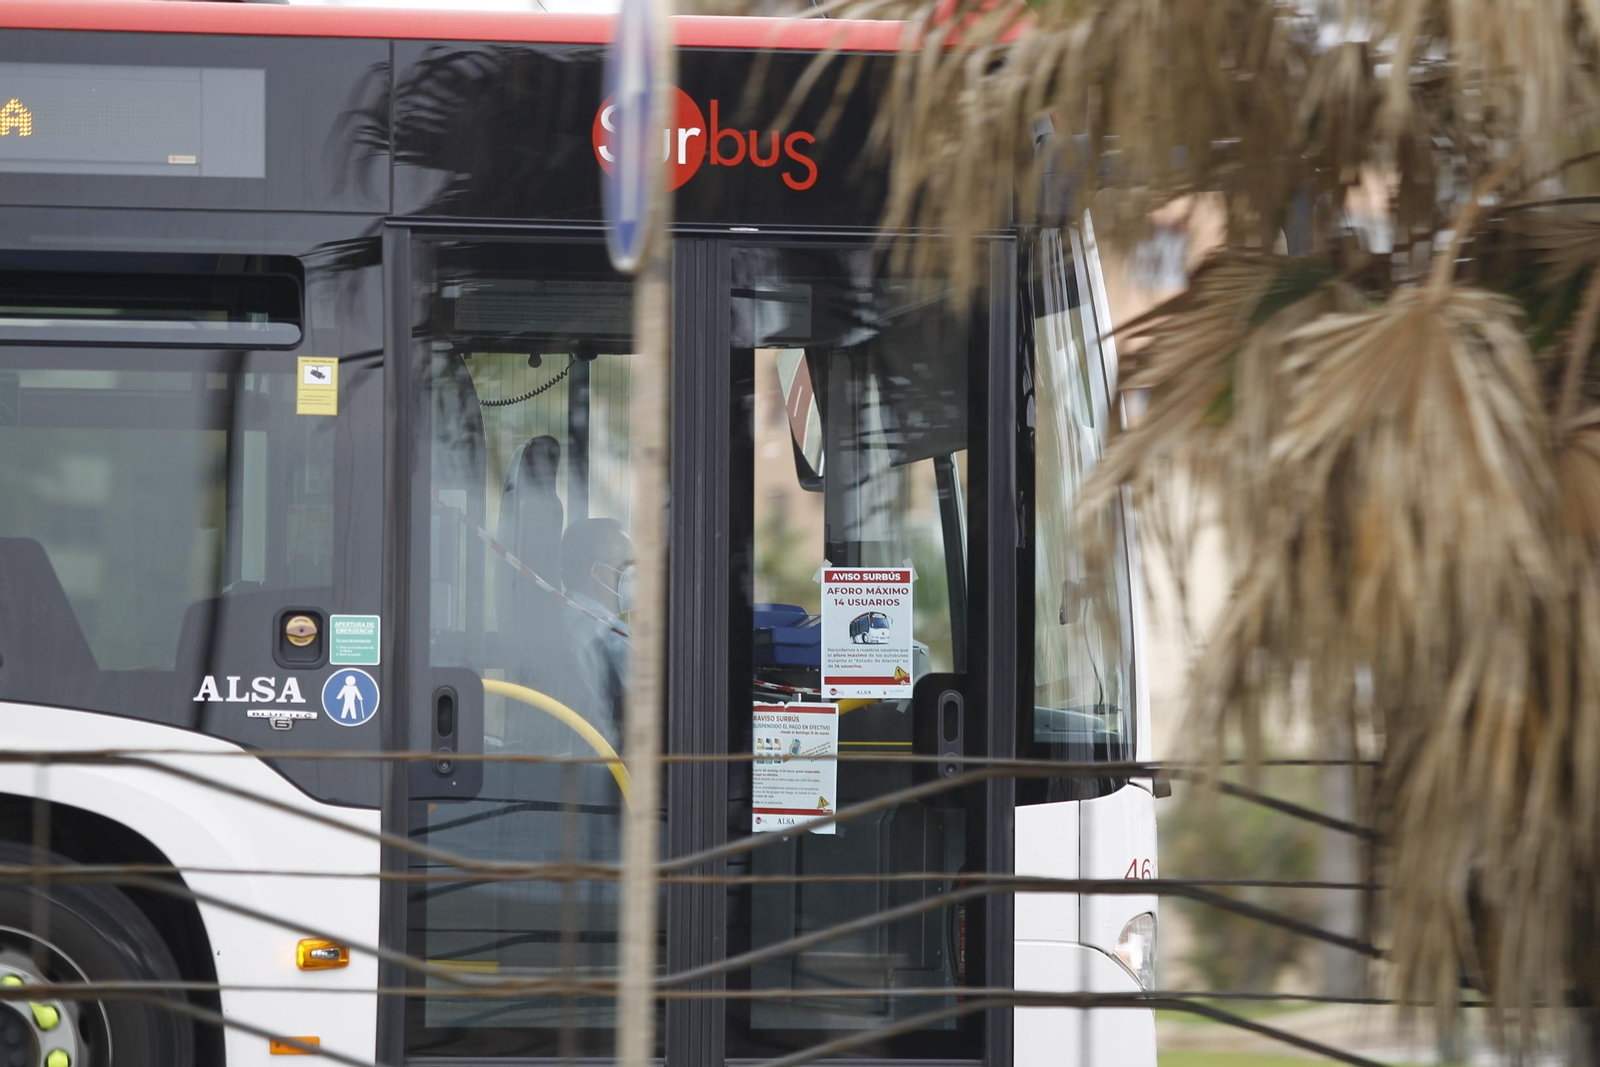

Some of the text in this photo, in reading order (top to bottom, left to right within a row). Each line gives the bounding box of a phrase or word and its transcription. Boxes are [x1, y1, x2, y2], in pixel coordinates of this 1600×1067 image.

[832, 571, 901, 581] AVISO SURBÚS
[866, 586, 909, 595] MÁXIMO
[193, 675, 306, 703] ALSA
[1124, 858, 1156, 880] 46
